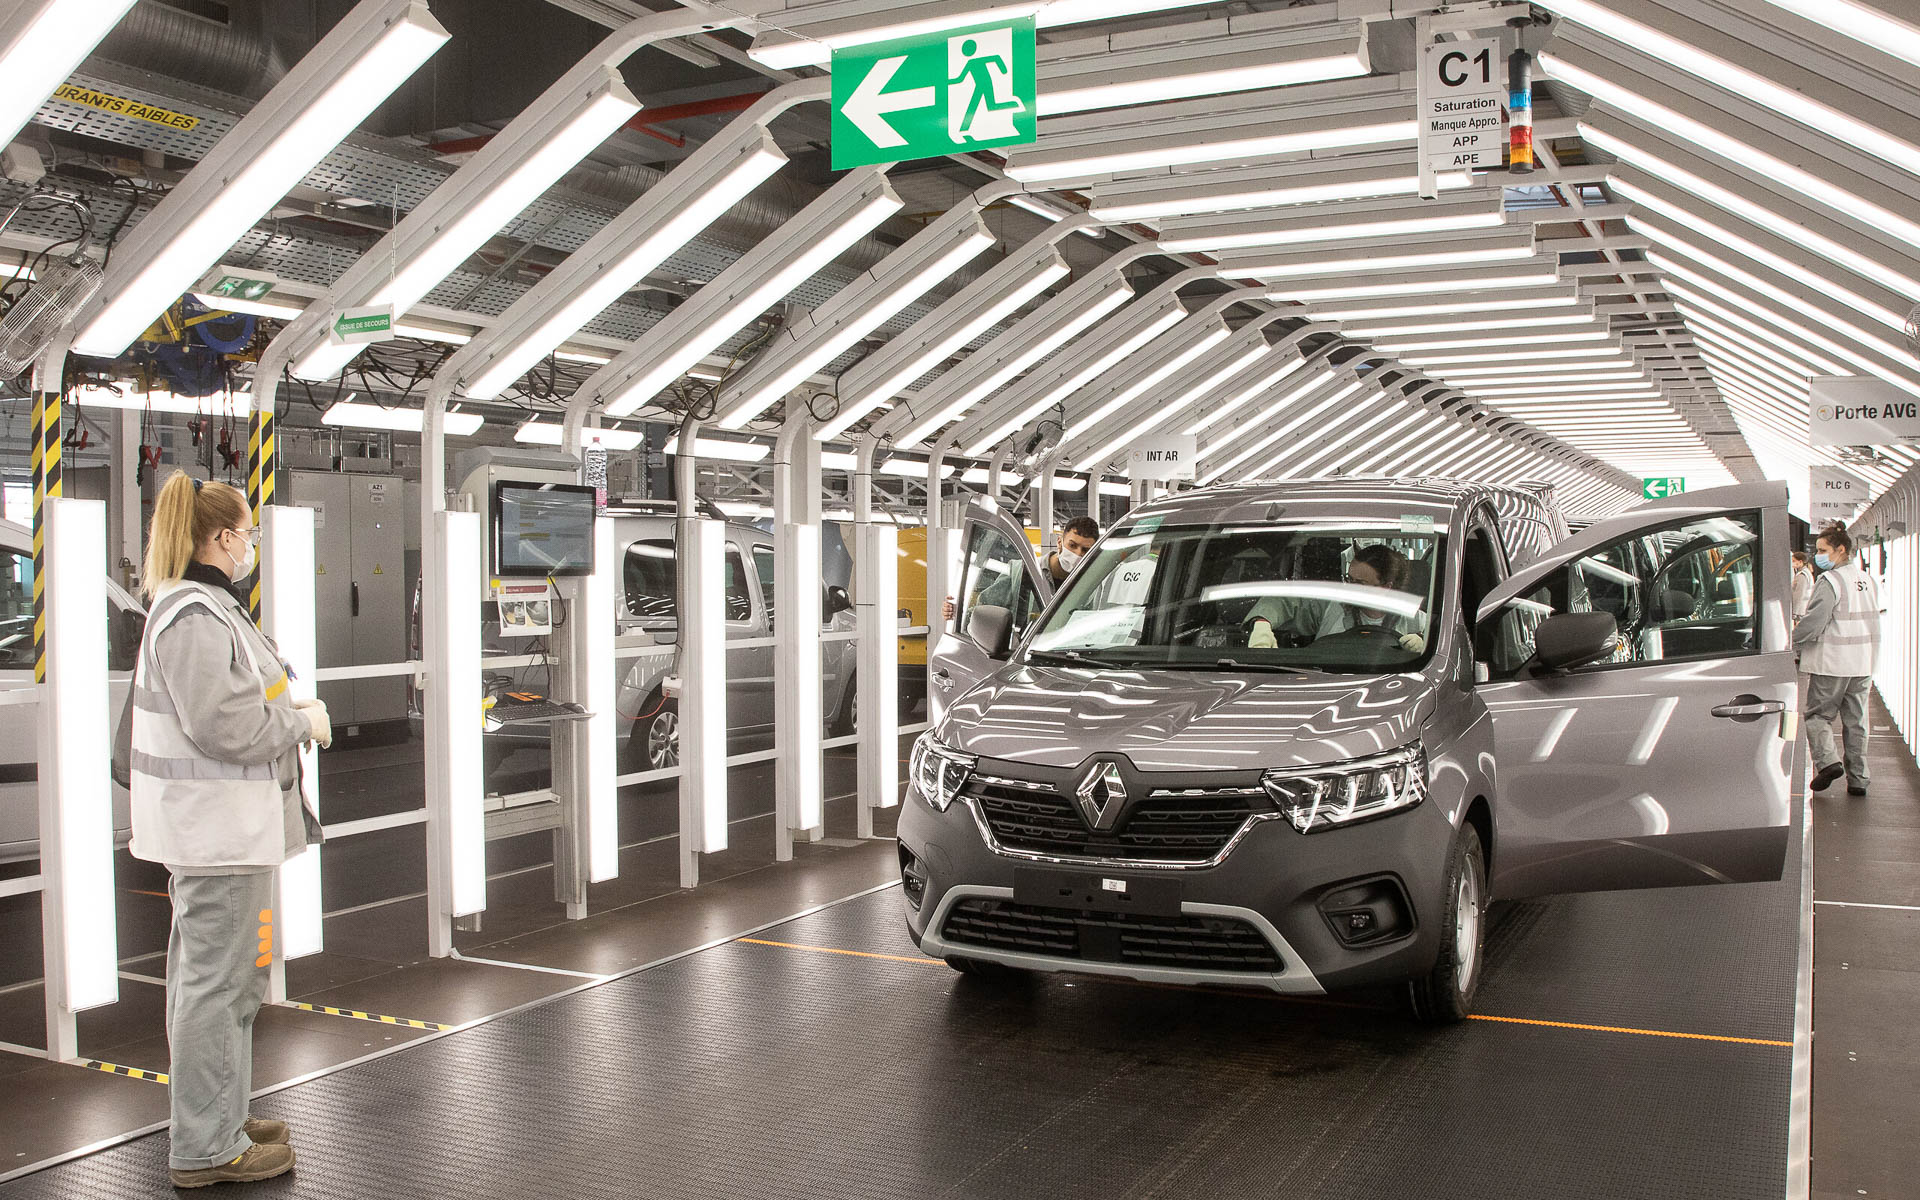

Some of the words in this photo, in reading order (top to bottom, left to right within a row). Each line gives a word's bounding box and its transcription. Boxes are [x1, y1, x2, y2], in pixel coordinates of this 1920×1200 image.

[1438, 47, 1490, 87] C1
[1434, 98, 1496, 113] Saturation
[125, 104, 194, 128] FAIBLES
[1431, 120, 1466, 131] Manque
[1468, 117, 1500, 129] Appro.
[1452, 135, 1479, 147] APP
[1453, 153, 1479, 165] APE
[340, 322, 356, 330] ISSUE
[356, 321, 364, 329] DE
[364, 318, 389, 328] SECOURS
[1835, 404, 1878, 420] Porte
[1882, 403, 1917, 419] AVG
[1147, 450, 1163, 461] INT
[1165, 450, 1178, 461] AR
[1825, 480, 1842, 489] PLC
[1844, 481, 1851, 489] G
